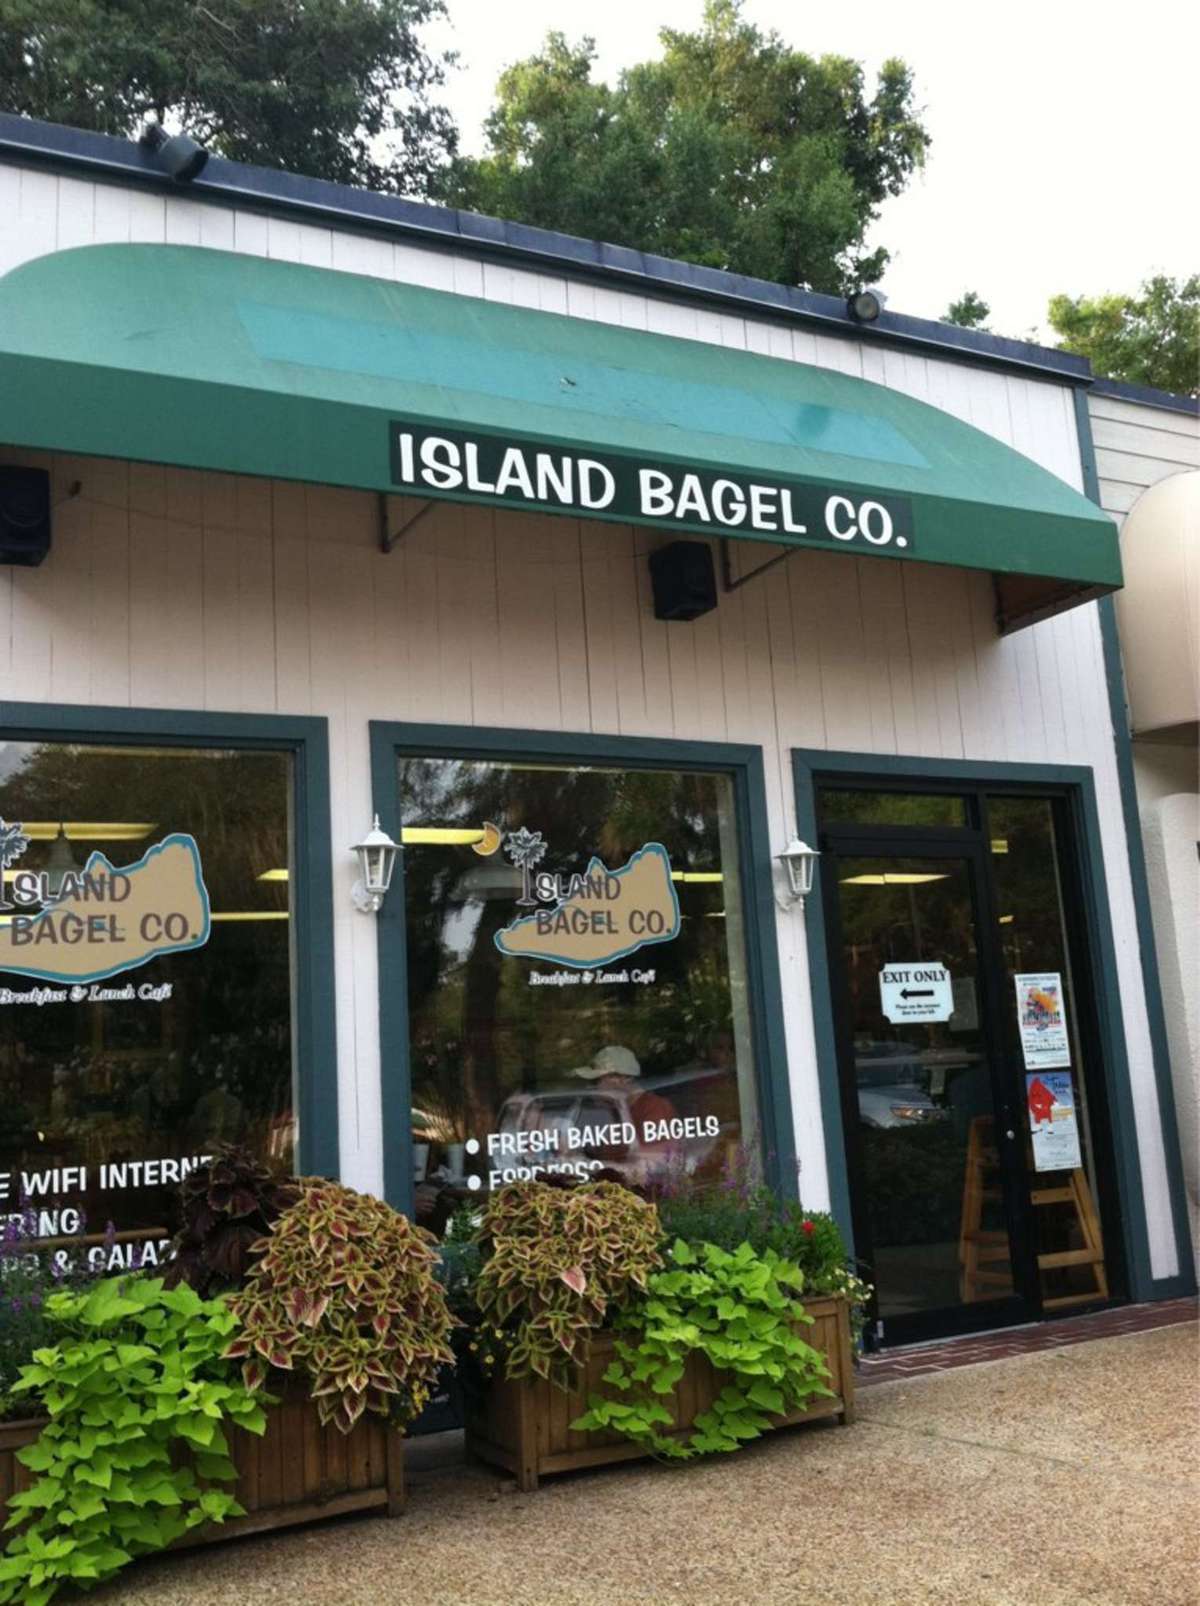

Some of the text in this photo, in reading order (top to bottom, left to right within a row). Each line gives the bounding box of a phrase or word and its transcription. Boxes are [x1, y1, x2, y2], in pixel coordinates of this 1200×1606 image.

[400, 433, 907, 547] ISLAND BAGEL CO.
[11, 912, 199, 947] BAGEL CO.
[536, 909, 673, 936] BAGEL CO.
[582, 970, 594, 985] &
[883, 970, 947, 983] EXIT ONLY
[69, 985, 87, 1003] &
[487, 1115, 720, 1157] FRESH BAKED BAGELS
[21, 1166, 87, 1196] WIFI
